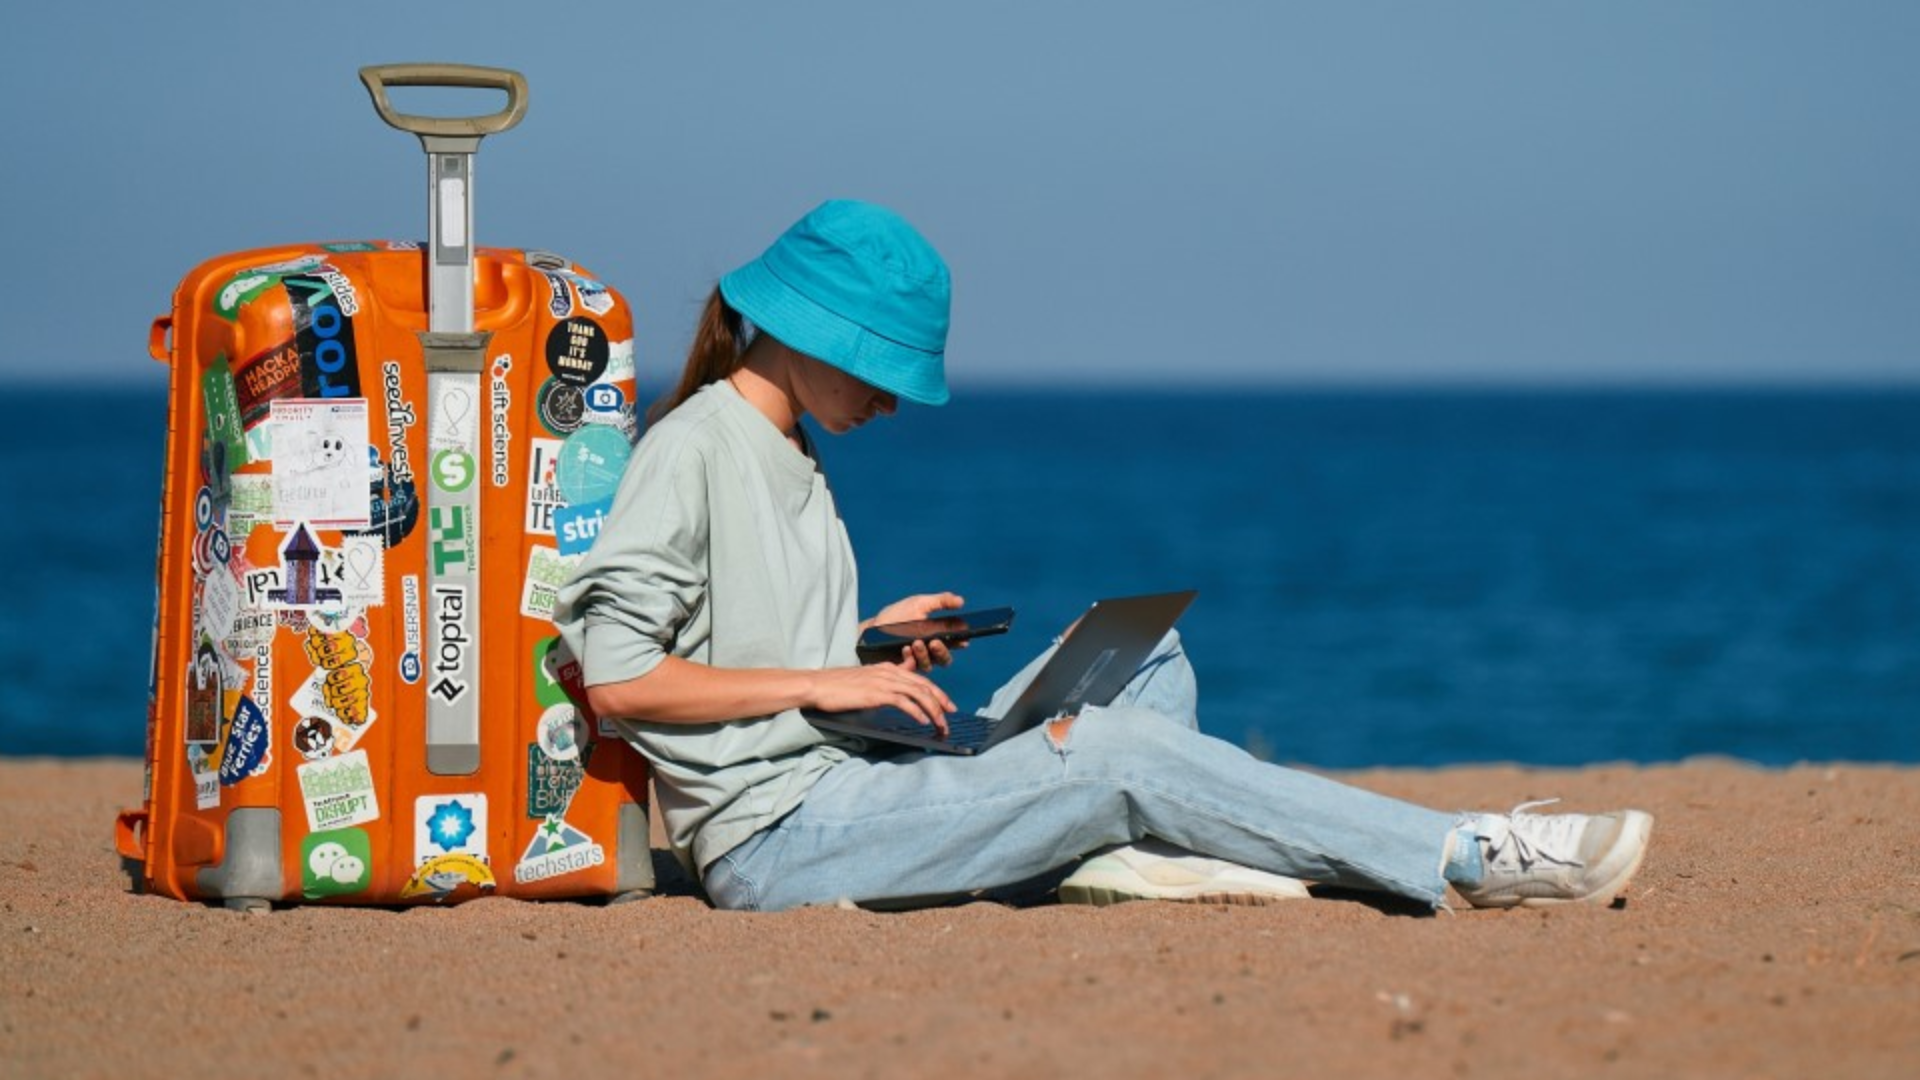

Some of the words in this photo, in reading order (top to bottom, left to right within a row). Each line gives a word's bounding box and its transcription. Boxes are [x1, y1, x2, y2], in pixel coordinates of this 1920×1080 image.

[567, 322, 595, 337] THANK
[570, 335, 588, 346] GOD
[245, 346, 298, 384] HACKA
[558, 355, 594, 371] MONDAY
[570, 346, 586, 358] IT'S
[494, 381, 509, 409] sift
[494, 413, 508, 485] science
[532, 502, 568, 531] TE
[563, 509, 607, 542] stri
[436, 588, 467, 673] toptal
[232, 705, 251, 739] Star
[229, 721, 263, 777] Ferries
[315, 795, 368, 823] DISRUPT
[517, 846, 602, 881] techstars
